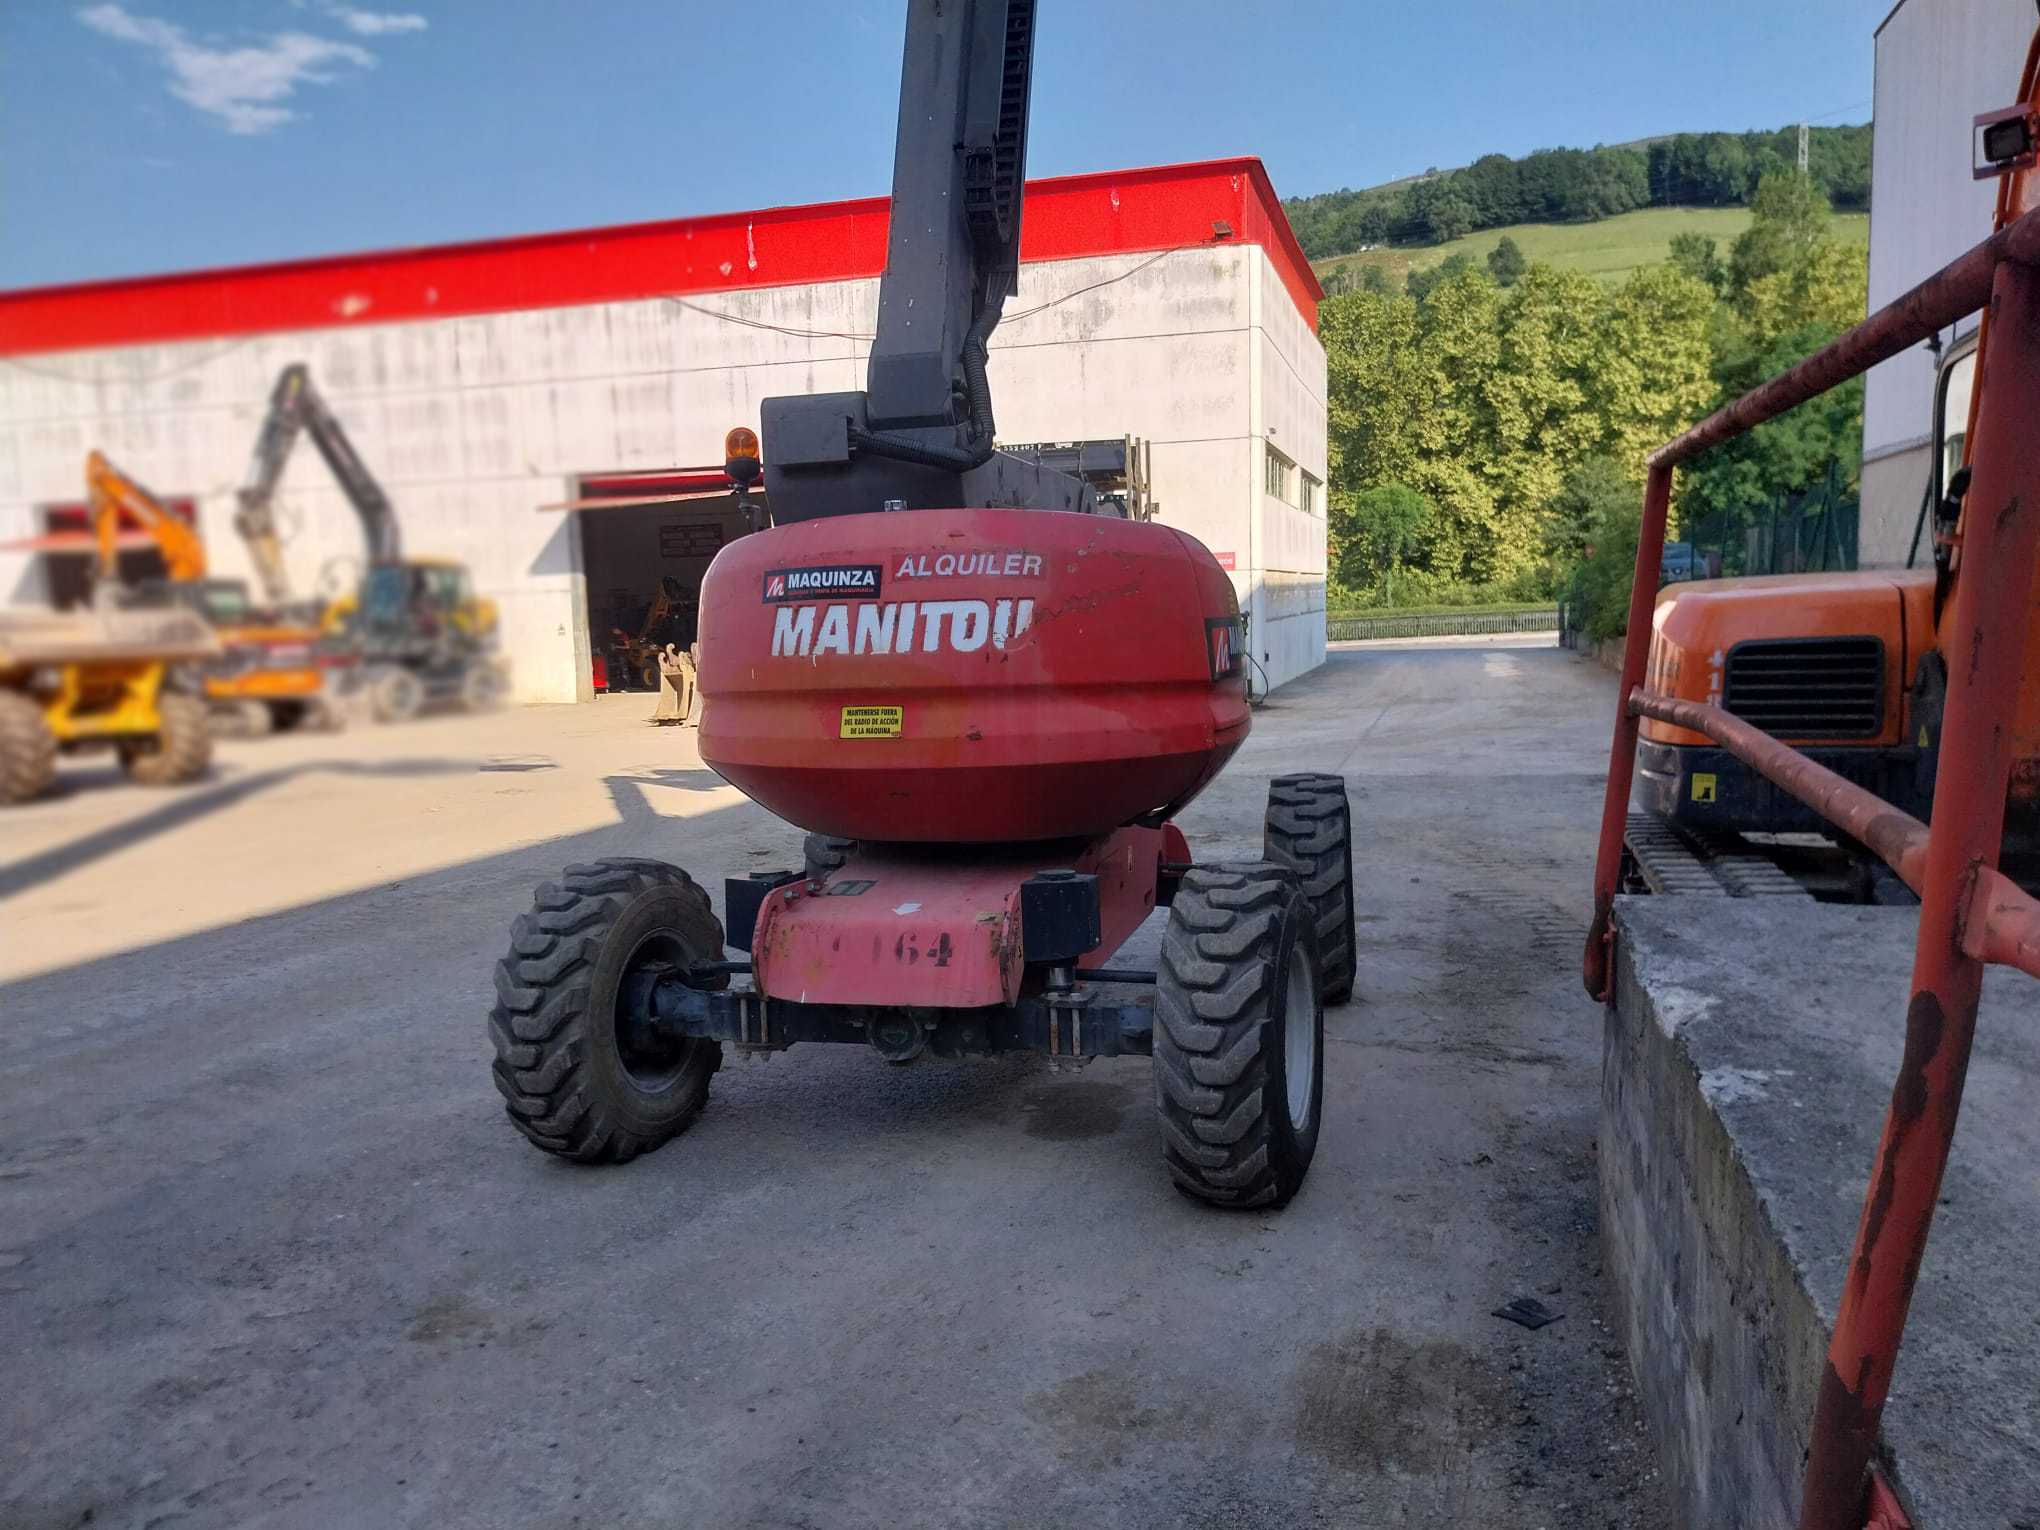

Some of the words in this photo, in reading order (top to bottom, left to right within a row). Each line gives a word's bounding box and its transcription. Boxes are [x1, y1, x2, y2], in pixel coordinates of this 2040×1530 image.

[896, 554, 1042, 578] ALQUILER
[788, 570, 875, 588] MAQUINZA
[771, 599, 1035, 657] MANITOU
